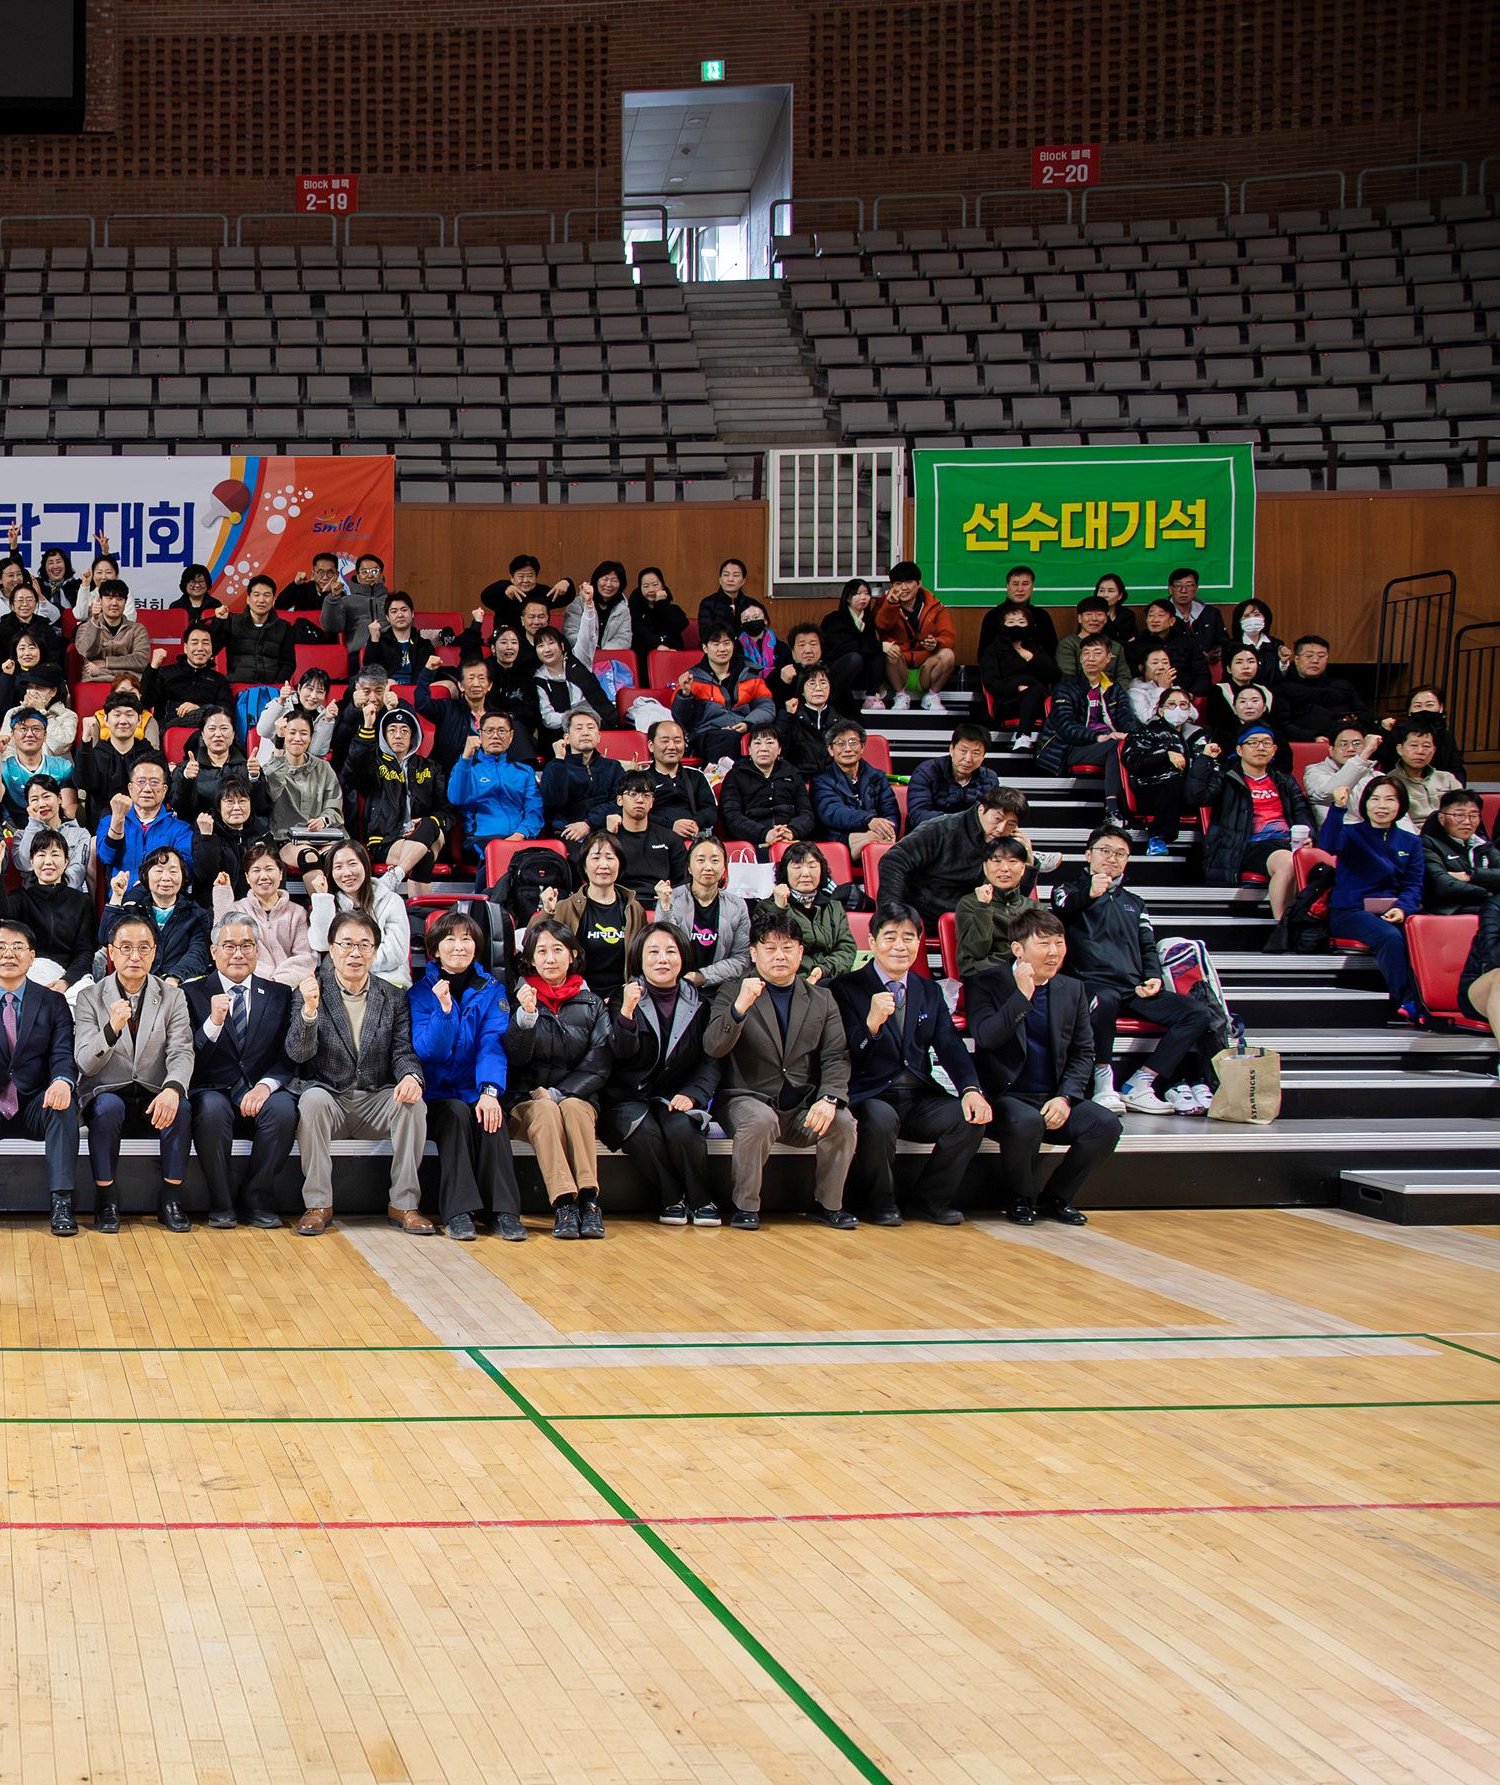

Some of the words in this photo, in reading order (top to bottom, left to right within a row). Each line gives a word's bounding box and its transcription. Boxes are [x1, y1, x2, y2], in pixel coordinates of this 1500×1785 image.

[1040, 151, 1068, 161] Block
[1042, 164, 1088, 184] 2-20
[303, 180, 329, 189] Block
[306, 193, 348, 210] 2-19
[962, 498, 1207, 552] 선수대기석
[1249, 1068, 1258, 1120] STARBUCKS
